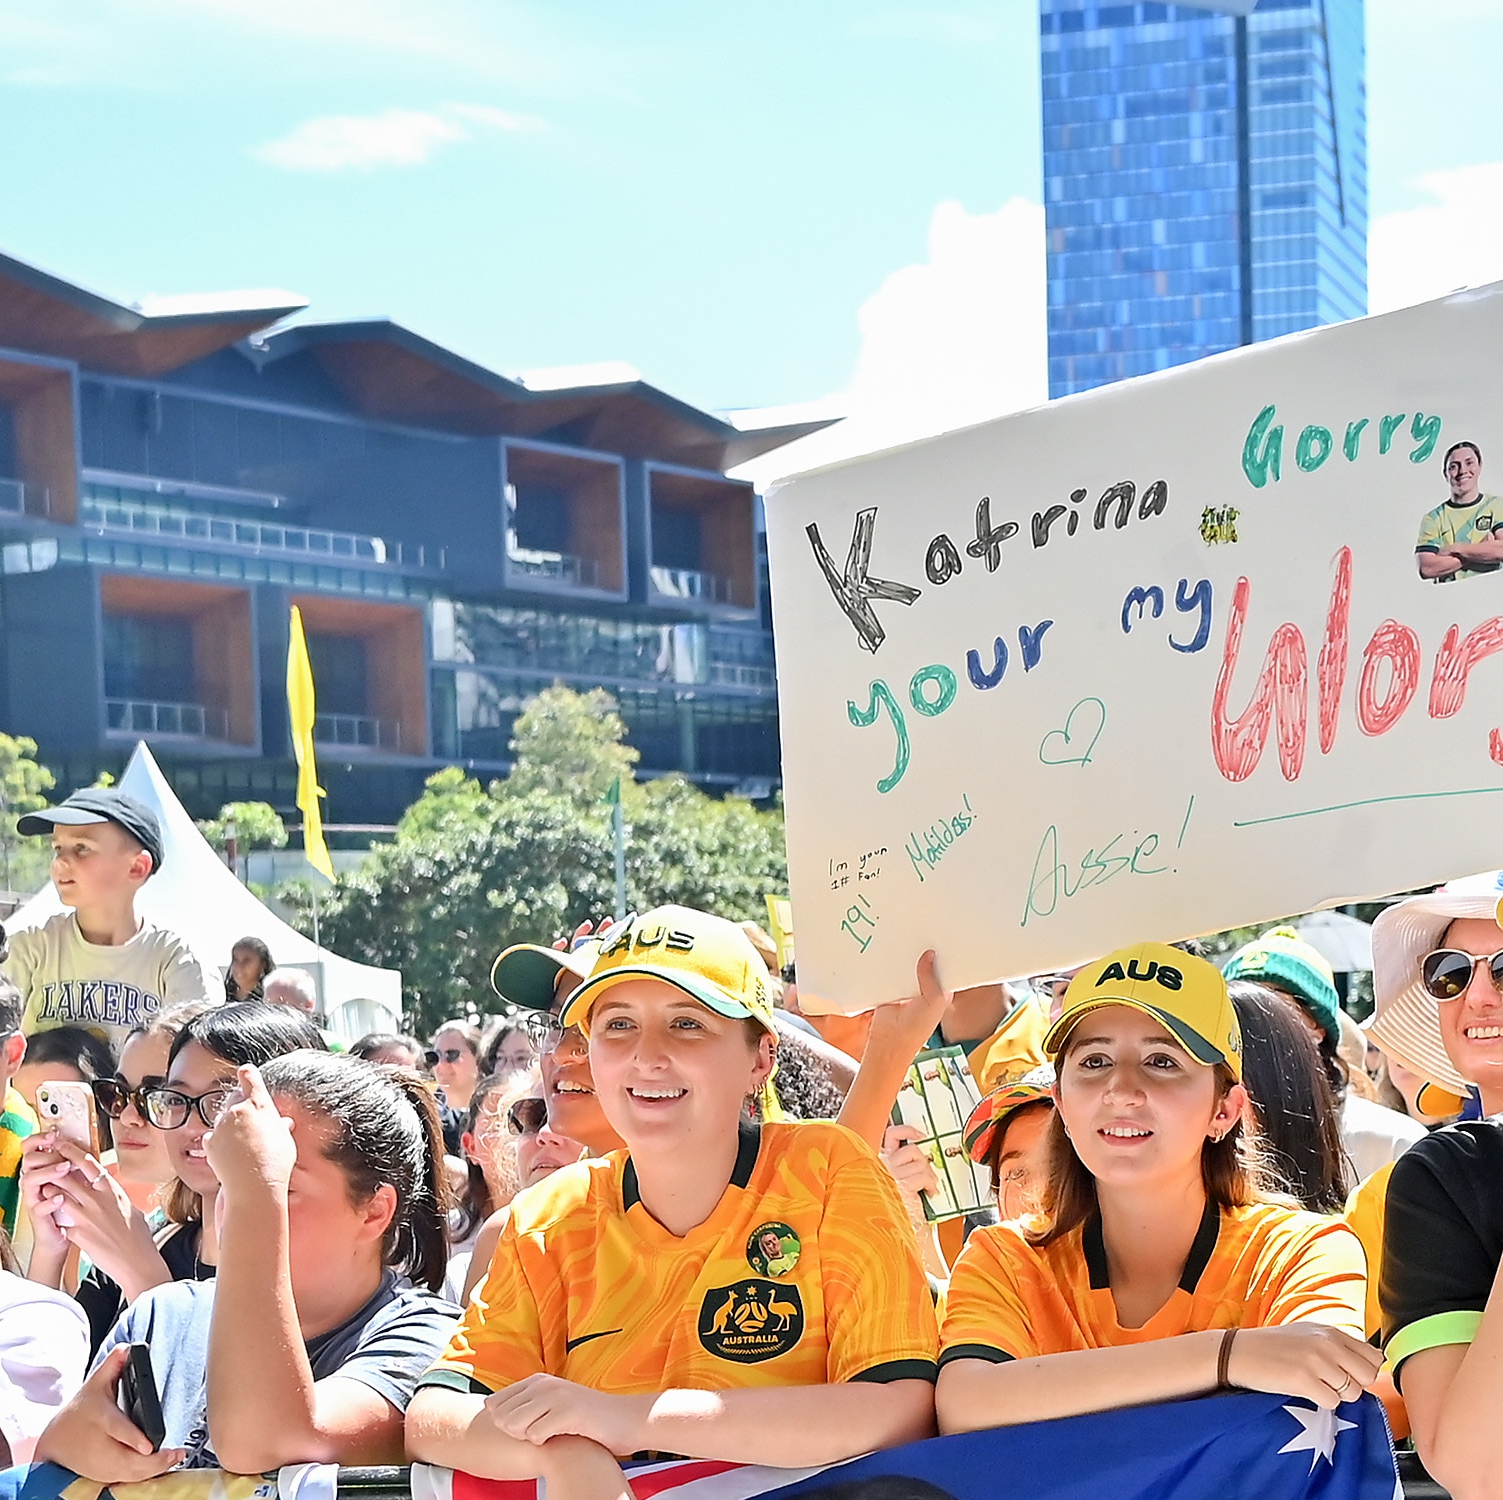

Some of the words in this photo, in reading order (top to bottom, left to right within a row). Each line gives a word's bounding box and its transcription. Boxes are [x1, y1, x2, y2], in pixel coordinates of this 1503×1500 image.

[805, 476, 1170, 654] Katrina
[1240, 403, 1443, 489] Gorry
[847, 617, 1054, 793] your
[1120, 573, 1214, 654] my
[904, 793, 978, 882] Matildas!
[1020, 794, 1196, 928] Aussie!
[1094, 959, 1184, 991] AUS
[722, 1334, 779, 1346] AUSTRALIA
